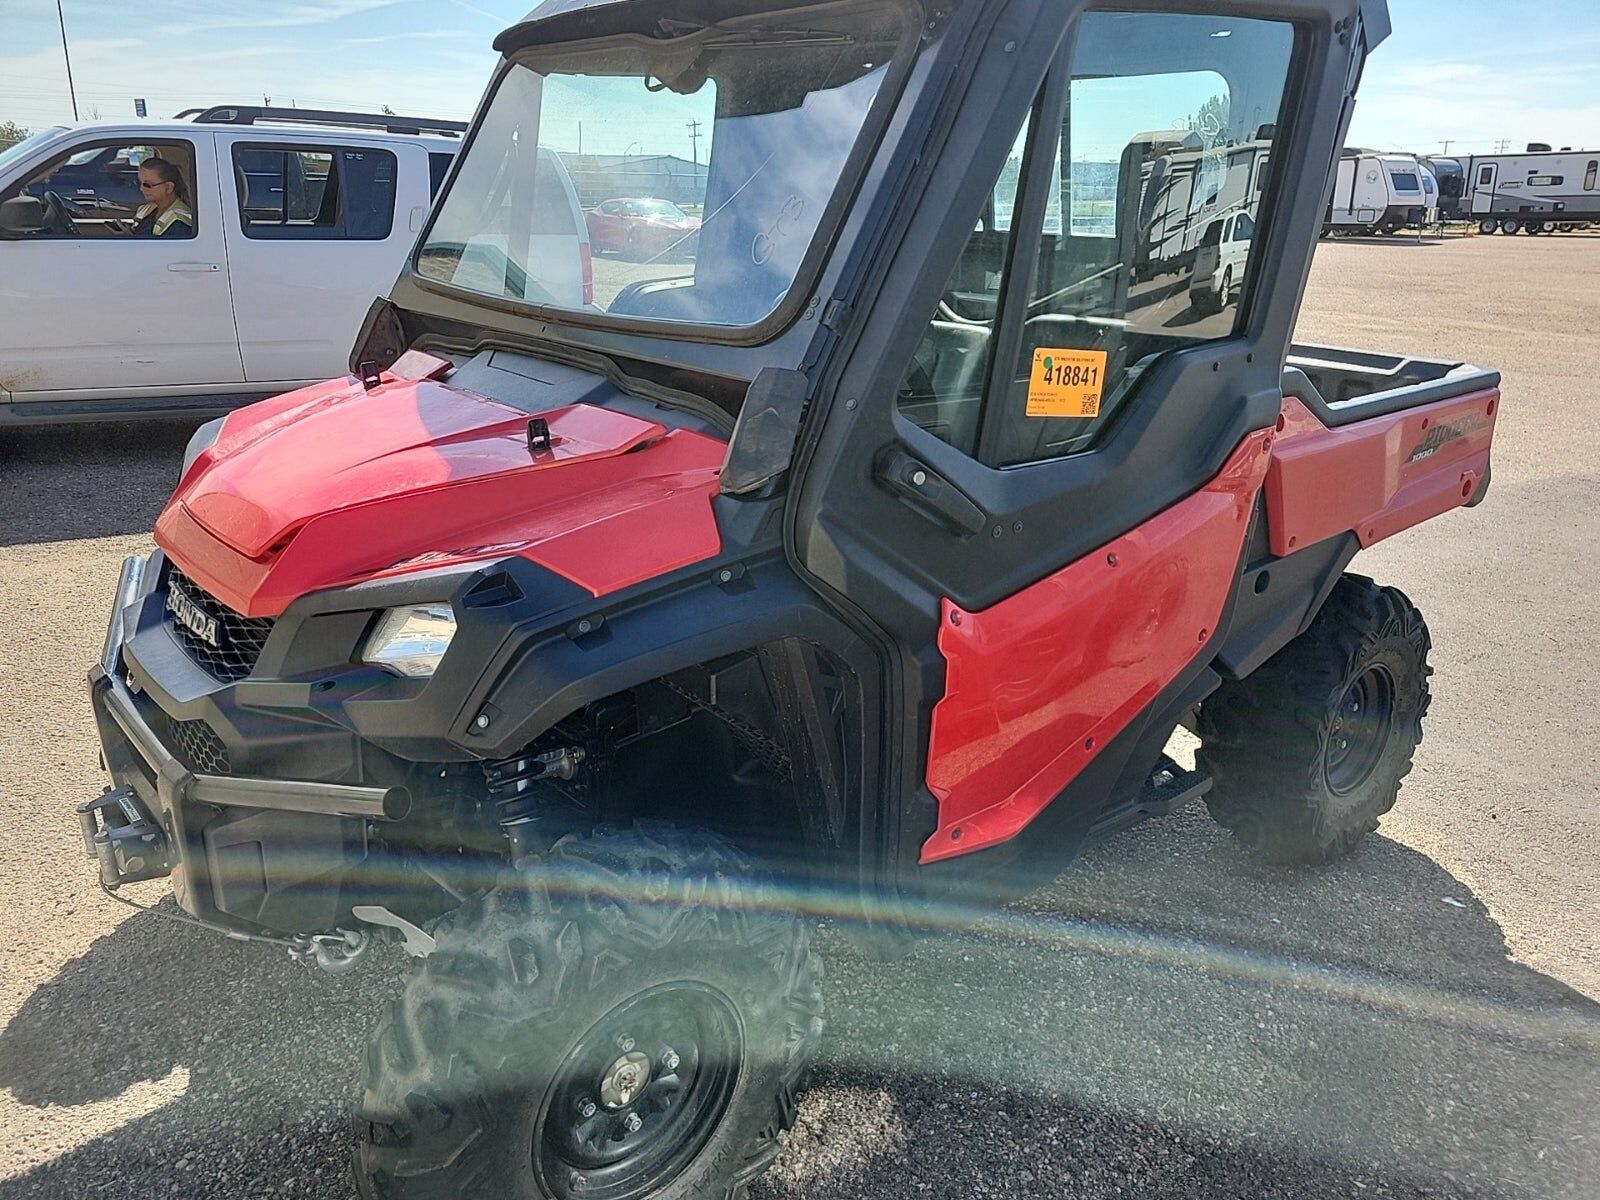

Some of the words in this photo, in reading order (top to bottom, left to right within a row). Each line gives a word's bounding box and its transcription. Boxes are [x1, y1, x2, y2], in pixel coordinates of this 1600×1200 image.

[1043, 364, 1098, 387] 418841
[1412, 448, 1434, 463] 1000
[166, 580, 217, 647] HONDA
